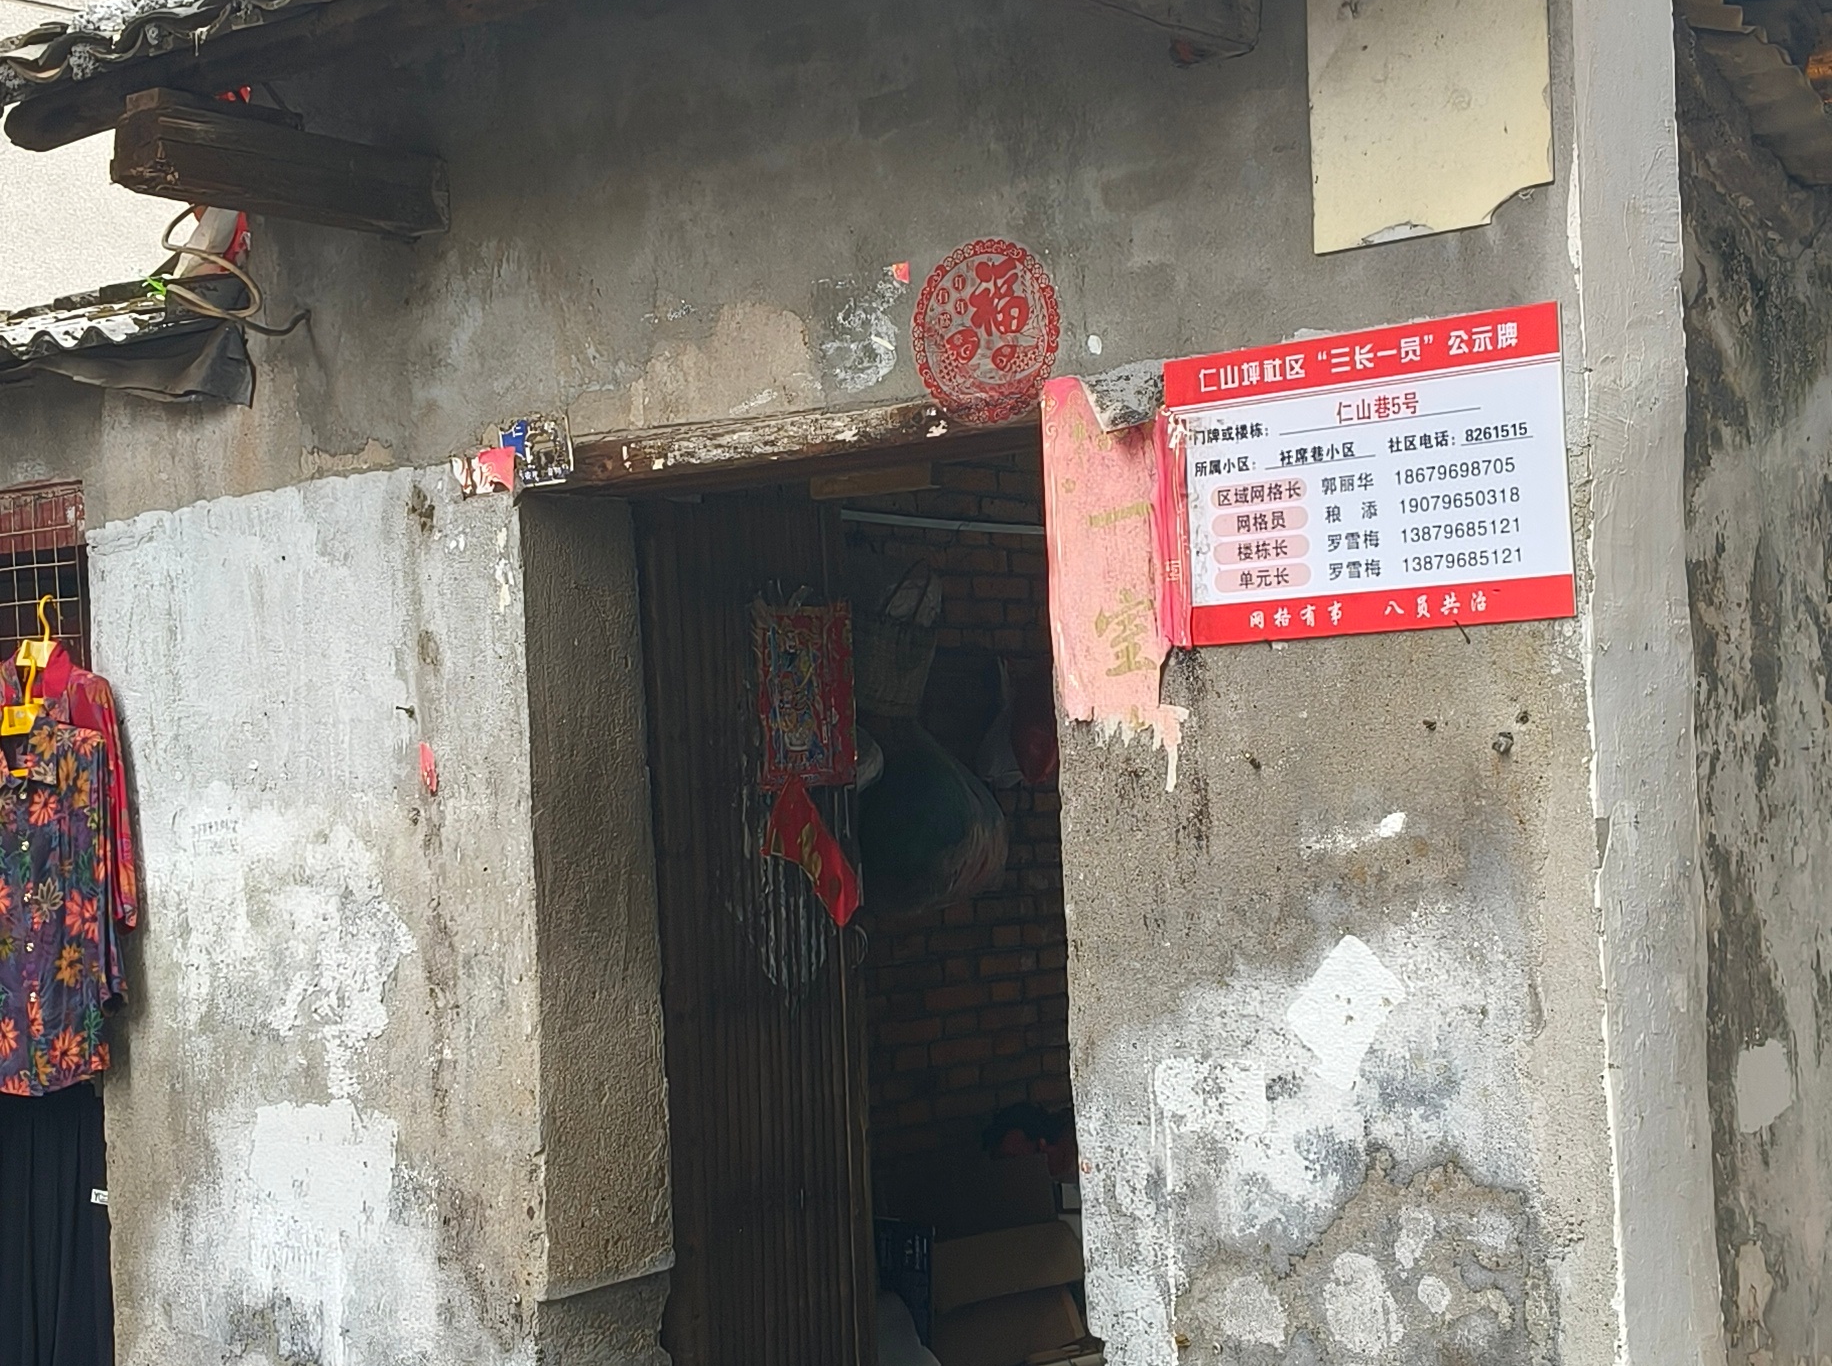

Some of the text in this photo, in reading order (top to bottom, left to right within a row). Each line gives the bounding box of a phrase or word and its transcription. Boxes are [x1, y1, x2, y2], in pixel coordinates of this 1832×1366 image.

[969, 257, 1029, 337] 福
[1337, 392, 1419, 424] 仁山巷5号
[1195, 456, 1257, 477] 所属小区：
[1388, 431, 1456, 454] 社区电话：
[1465, 422, 1528, 442] 8261515
[1217, 457, 1516, 506] 区域网格长 郭丽华 18679698705
[1236, 511, 1286, 533] 网格员
[1399, 487, 1520, 514] 19079650318
[1237, 518, 1520, 561] 楼栋长 罗雪梅 13879685121
[1239, 547, 1522, 589] 单元长 罗雪梅 13879685121
[1249, 601, 1342, 629] 网格有事
